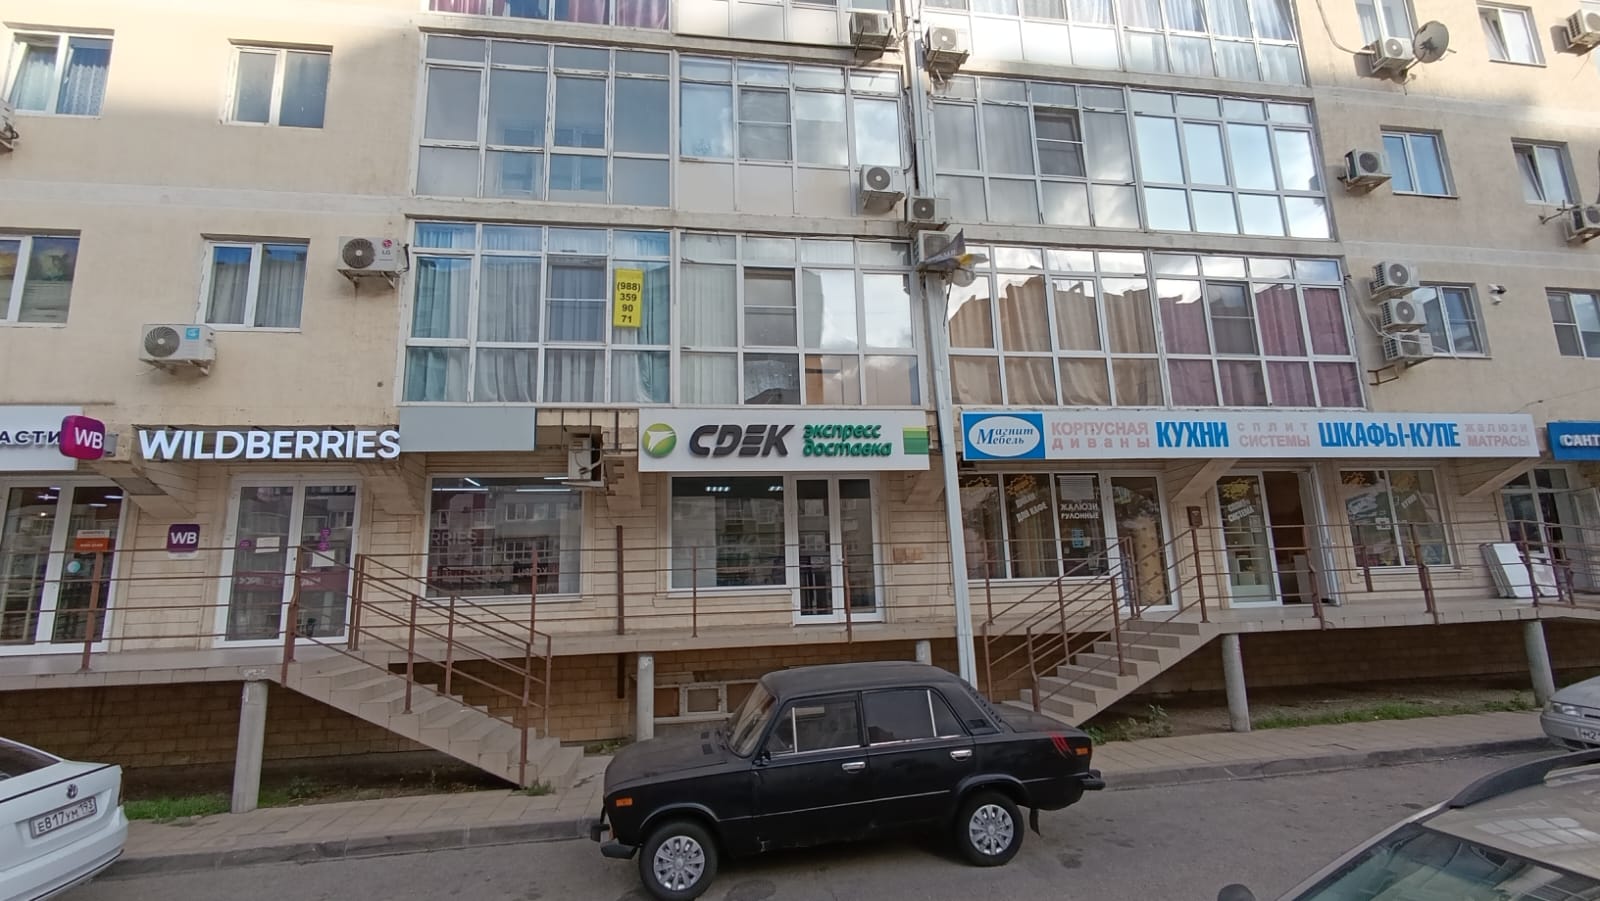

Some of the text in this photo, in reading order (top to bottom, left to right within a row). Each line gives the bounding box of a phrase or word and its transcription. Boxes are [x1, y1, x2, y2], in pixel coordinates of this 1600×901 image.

[617, 282, 641, 292] (988)
[620, 293, 637, 302] 359
[622, 304, 634, 312] 90
[621, 315, 632, 323] 71
[803, 425, 881, 442] экспресс
[1051, 422, 1149, 435] КОРПУСНАЯ
[1156, 422, 1229, 447] КУХНИ
[1318, 422, 1461, 447] ШКАФЫ-КУПЕ
[75, 427, 103, 449] WB
[689, 424, 795, 457] CDEK
[977, 428, 1033, 444] Магнит
[1239, 435, 1310, 447] СИСТЕМЫ
[1467, 435, 1530, 447] МАТРАСЫ
[138, 430, 400, 459] WILDBERRIES
[803, 439, 892, 457] доставка
[1061, 503, 1098, 511] ЖАЛЮЗИ
[171, 532, 197, 544] WB
